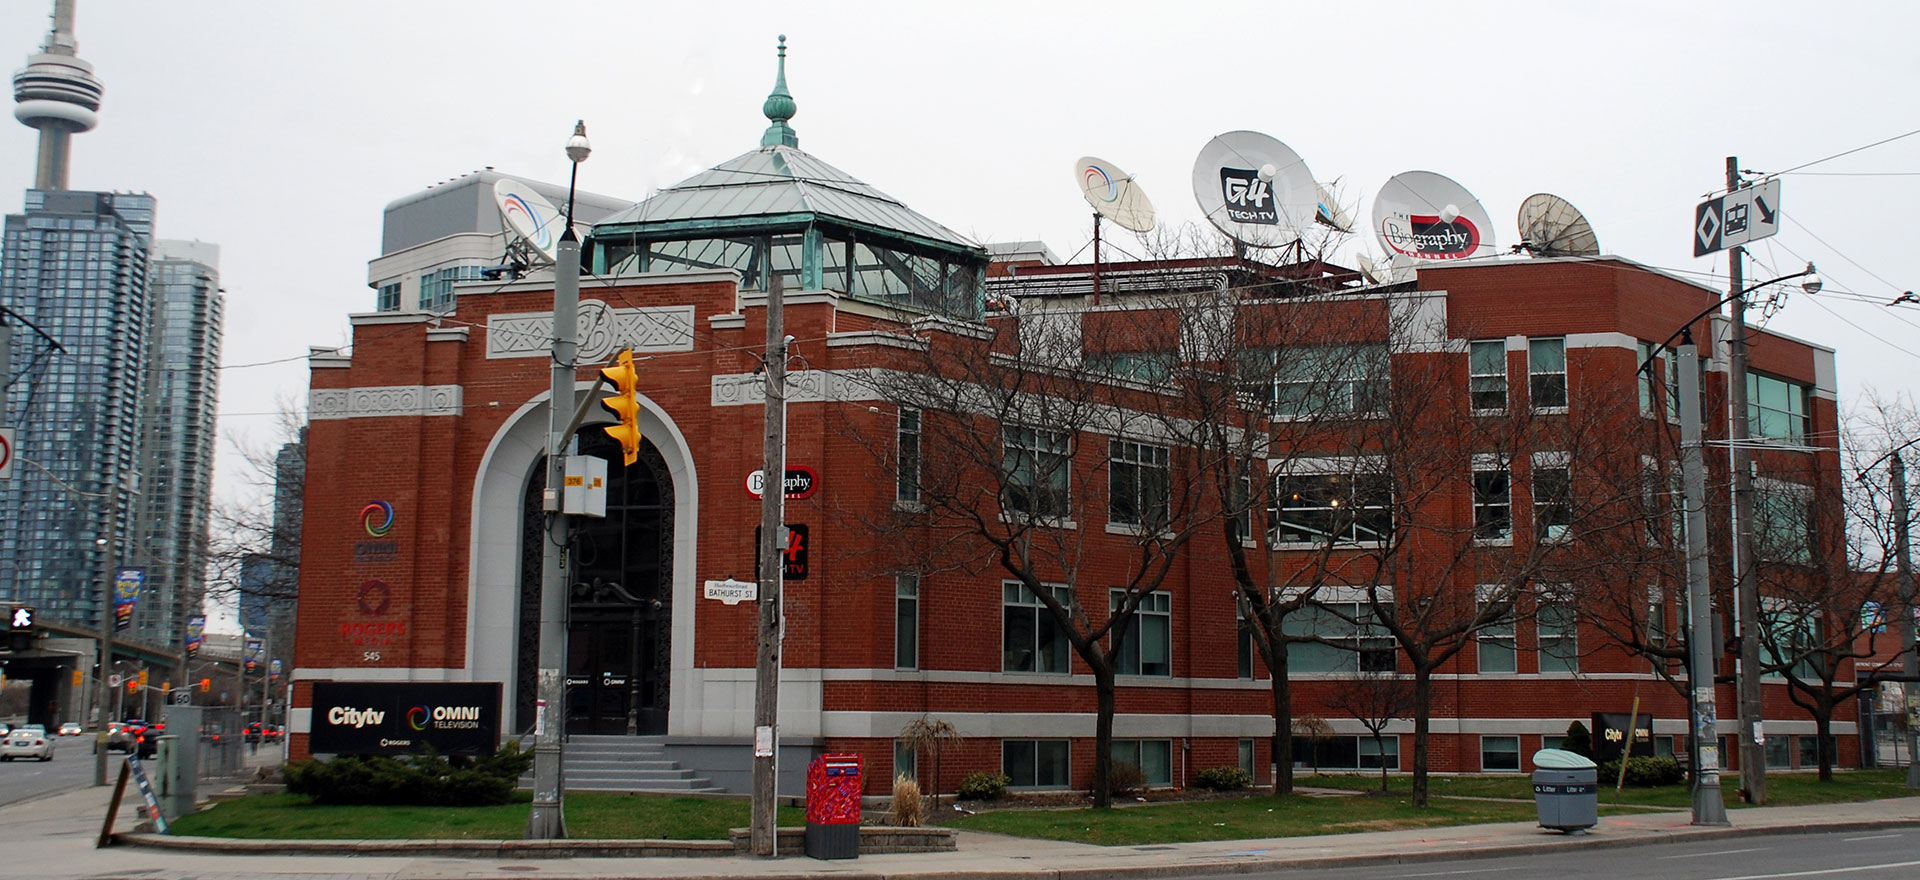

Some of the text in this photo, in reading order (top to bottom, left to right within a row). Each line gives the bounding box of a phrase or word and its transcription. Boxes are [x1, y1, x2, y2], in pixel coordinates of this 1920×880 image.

[1226, 177, 1270, 208] G4
[1228, 209, 1275, 220] TECH TV
[1393, 211, 1409, 220] THE
[1387, 222, 1468, 251] Biography
[753, 474, 812, 491] Baphy
[790, 564, 804, 574] TV
[708, 588, 742, 598] BATHURST
[340, 622, 406, 636] ROGERS
[363, 651, 381, 662] 545
[176, 694, 190, 704] 60
[328, 706, 480, 729] Citytv OMNI
[434, 721, 479, 729] TELEVISION
